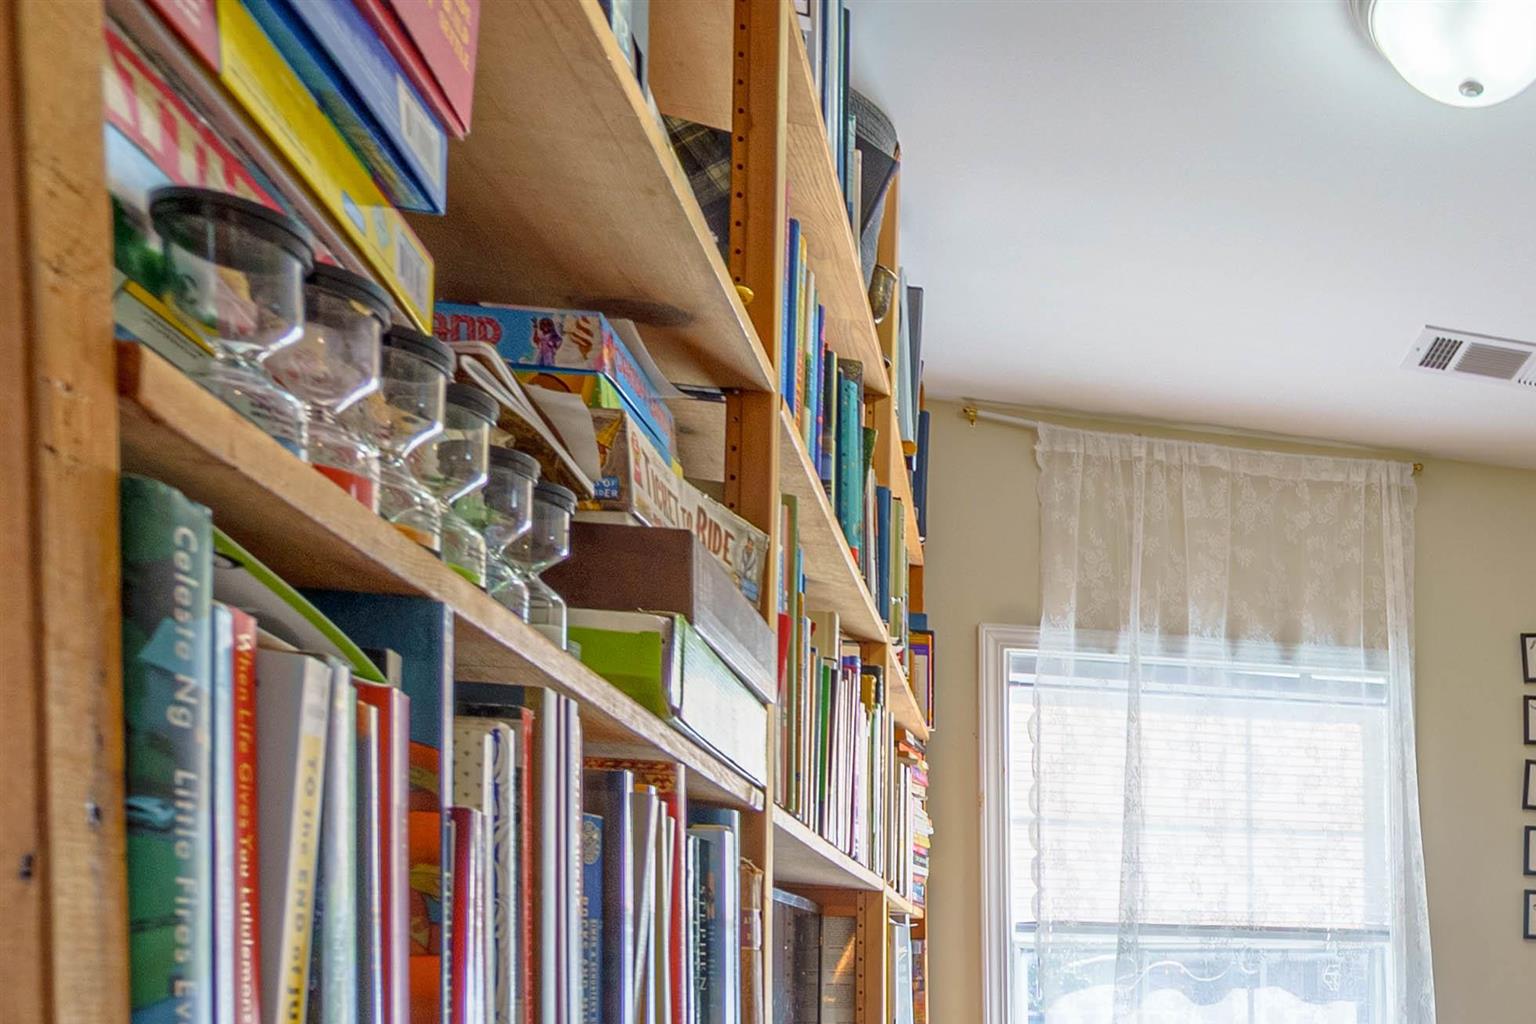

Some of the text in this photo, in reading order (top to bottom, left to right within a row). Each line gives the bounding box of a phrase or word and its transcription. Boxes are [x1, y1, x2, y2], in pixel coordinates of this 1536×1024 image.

[696, 504, 736, 567] RIDE
[173, 526, 199, 661] Celeste
[237, 633, 253, 701] When
[166, 673, 199, 729] Ng
[238, 708, 254, 753] Life
[174, 768, 200, 860] Little
[238, 762, 254, 828] Gives
[239, 834, 255, 878] You
[174, 876, 197, 963] Fires
